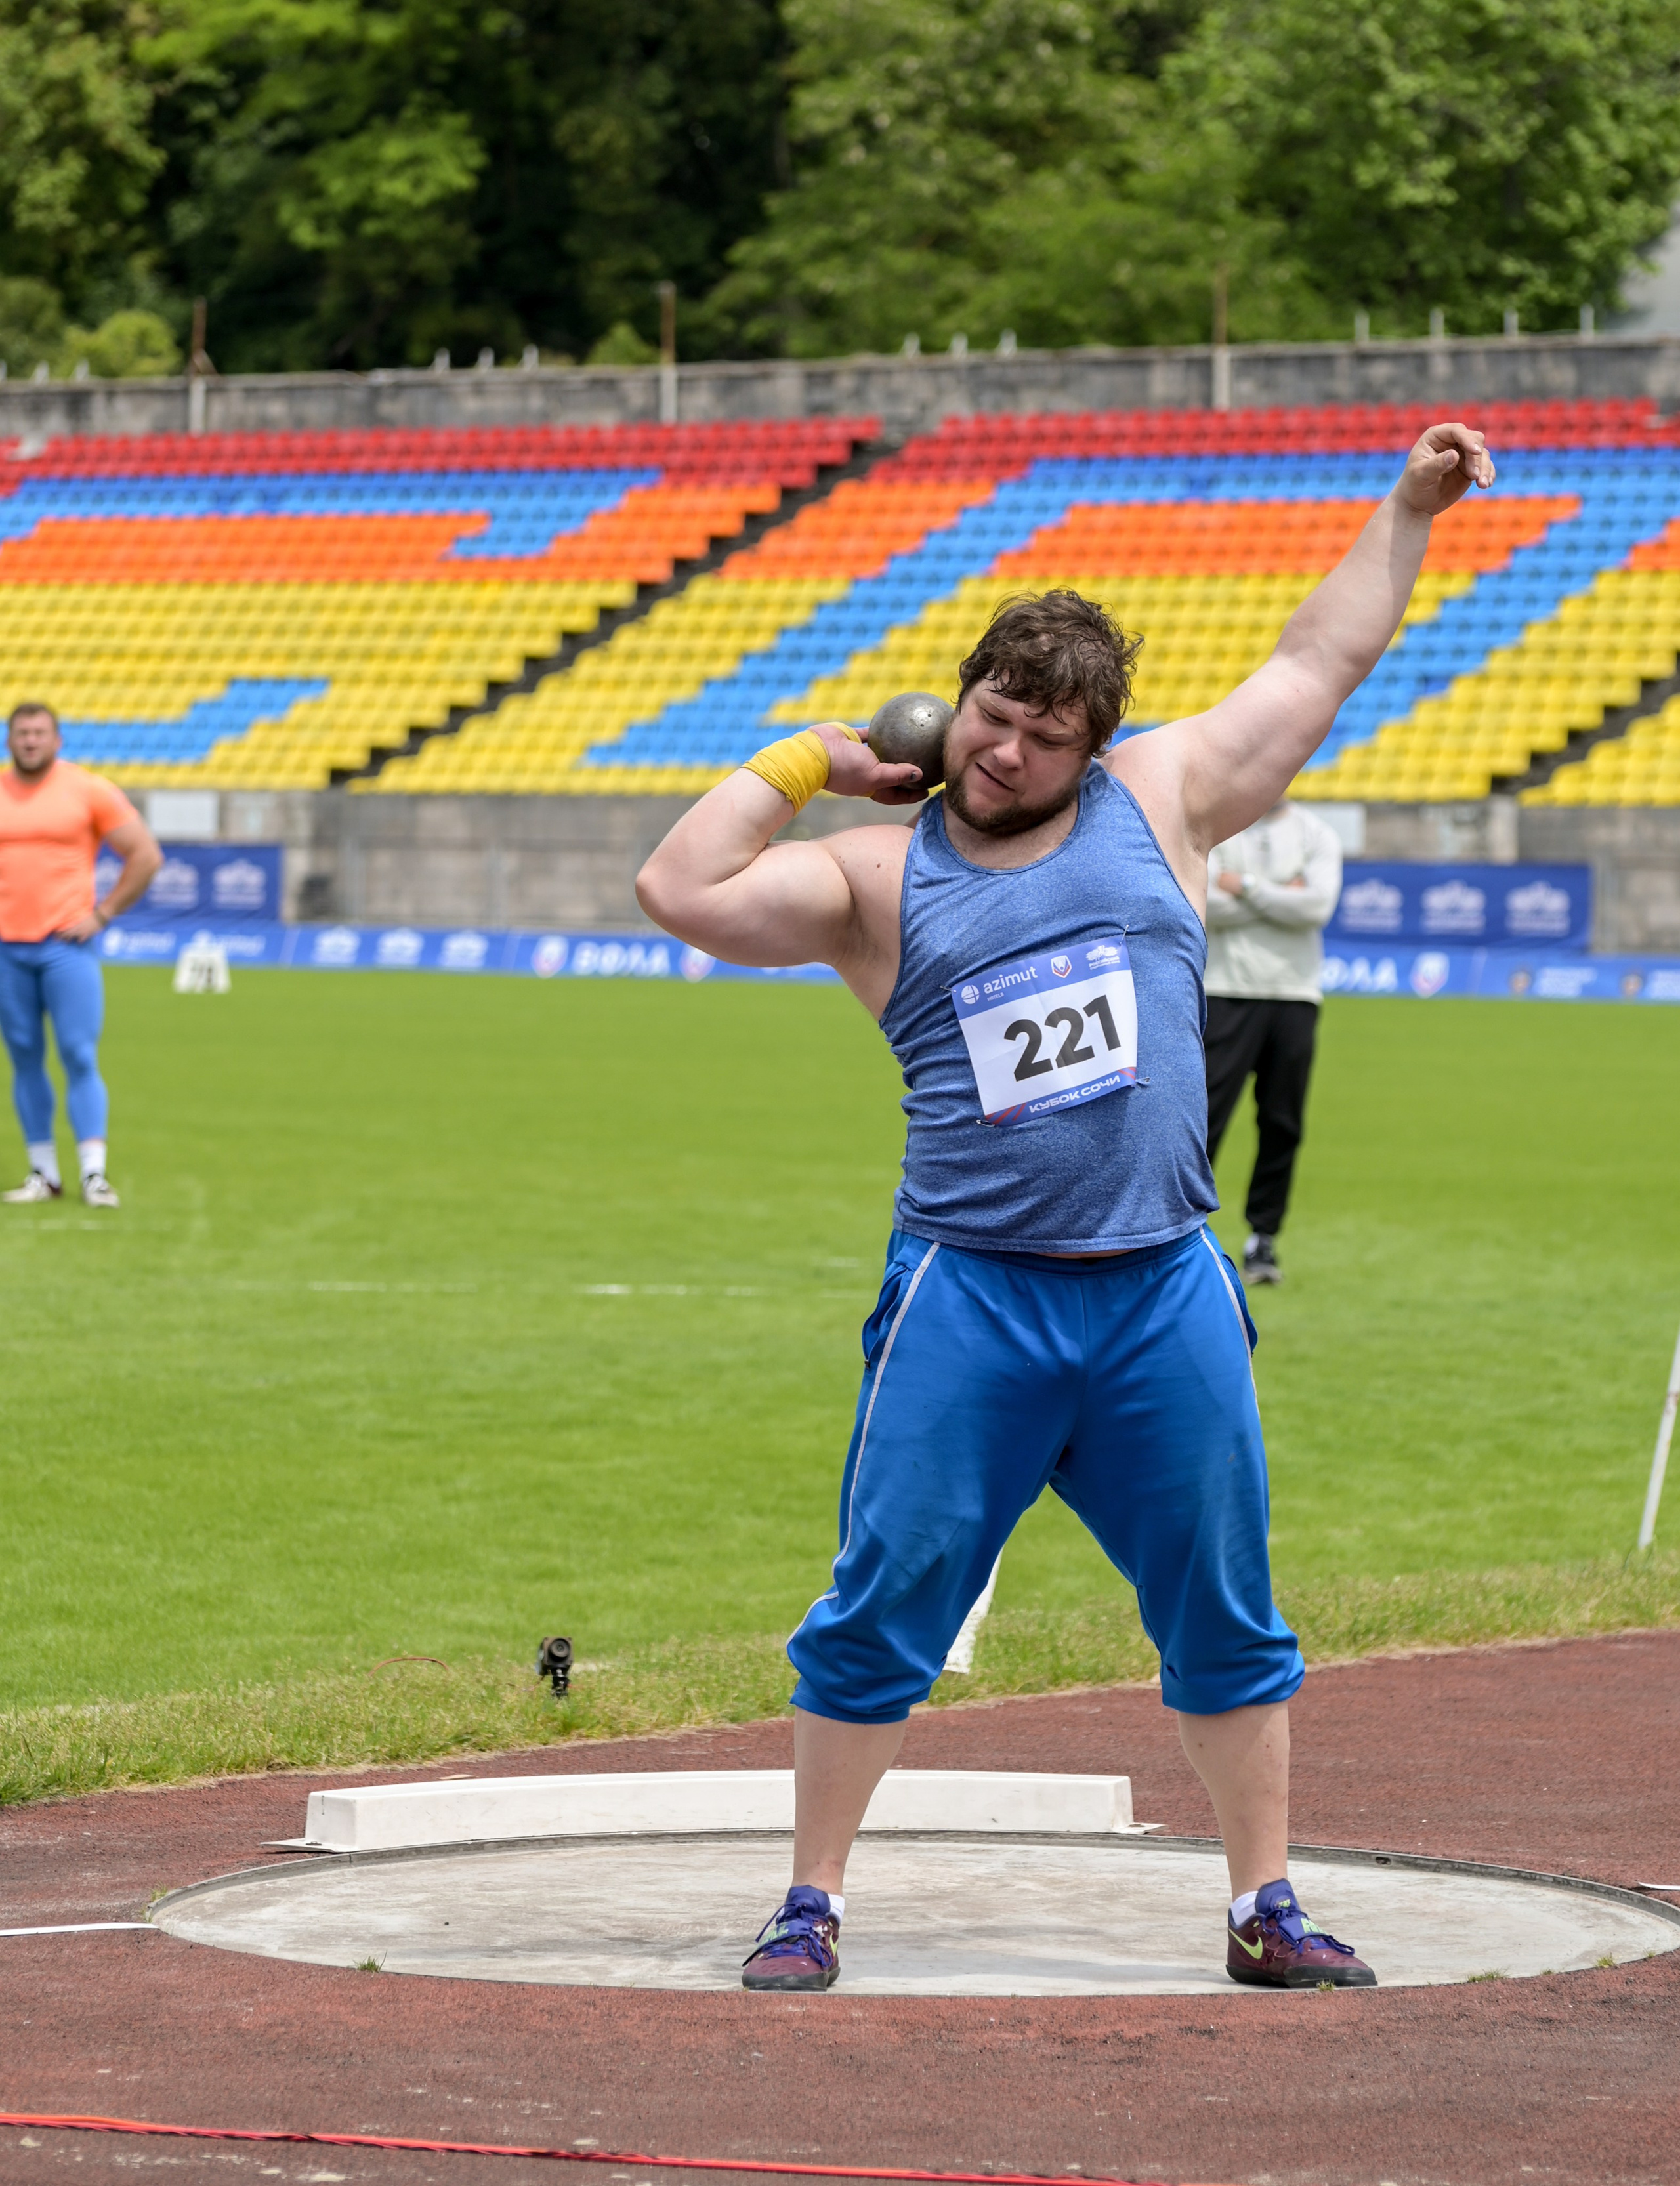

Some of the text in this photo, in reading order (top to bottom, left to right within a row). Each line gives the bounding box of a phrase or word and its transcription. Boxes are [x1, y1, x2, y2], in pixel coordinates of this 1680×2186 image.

[983, 966, 1038, 994] azimut
[987, 992, 1004, 1001] HOTELS
[1003, 994, 1122, 1082] 221
[1029, 1075, 1120, 1113] КУБОК СОЧИ
